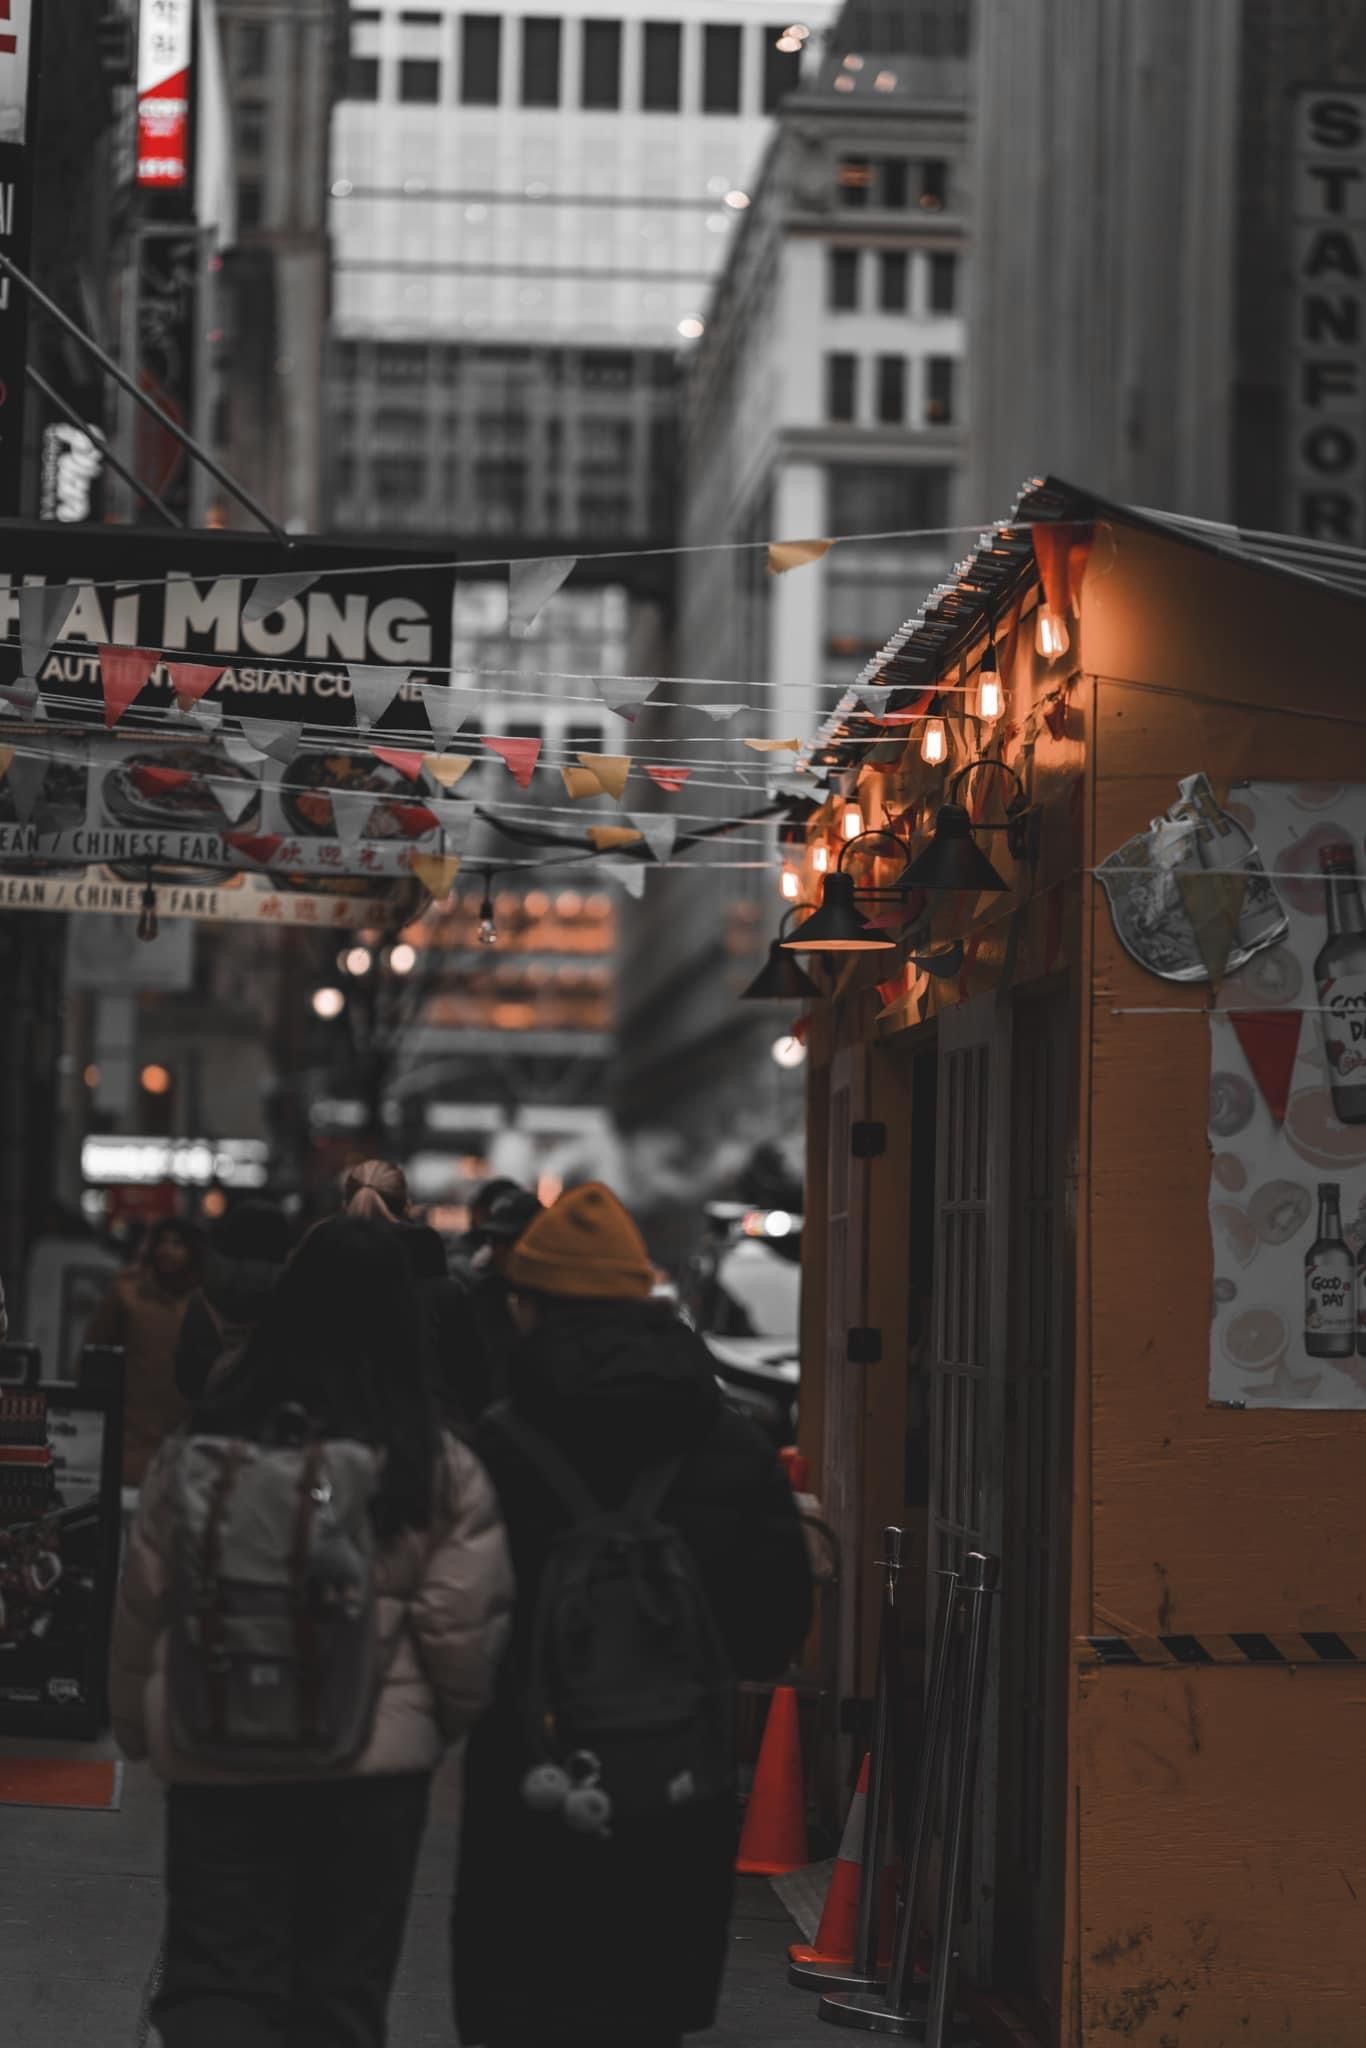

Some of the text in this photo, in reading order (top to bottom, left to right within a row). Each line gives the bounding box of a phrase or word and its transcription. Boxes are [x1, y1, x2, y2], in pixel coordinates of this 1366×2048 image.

[163, 571, 432, 663] MONG
[216, 666, 307, 697] ASIAN
[73, 831, 166, 858] CHINESE
[180, 834, 231, 861] FARE
[171, 889, 218, 914] FARE
[1311, 1276, 1342, 1292] GOOD
[1321, 1292, 1345, 1307] DAY
